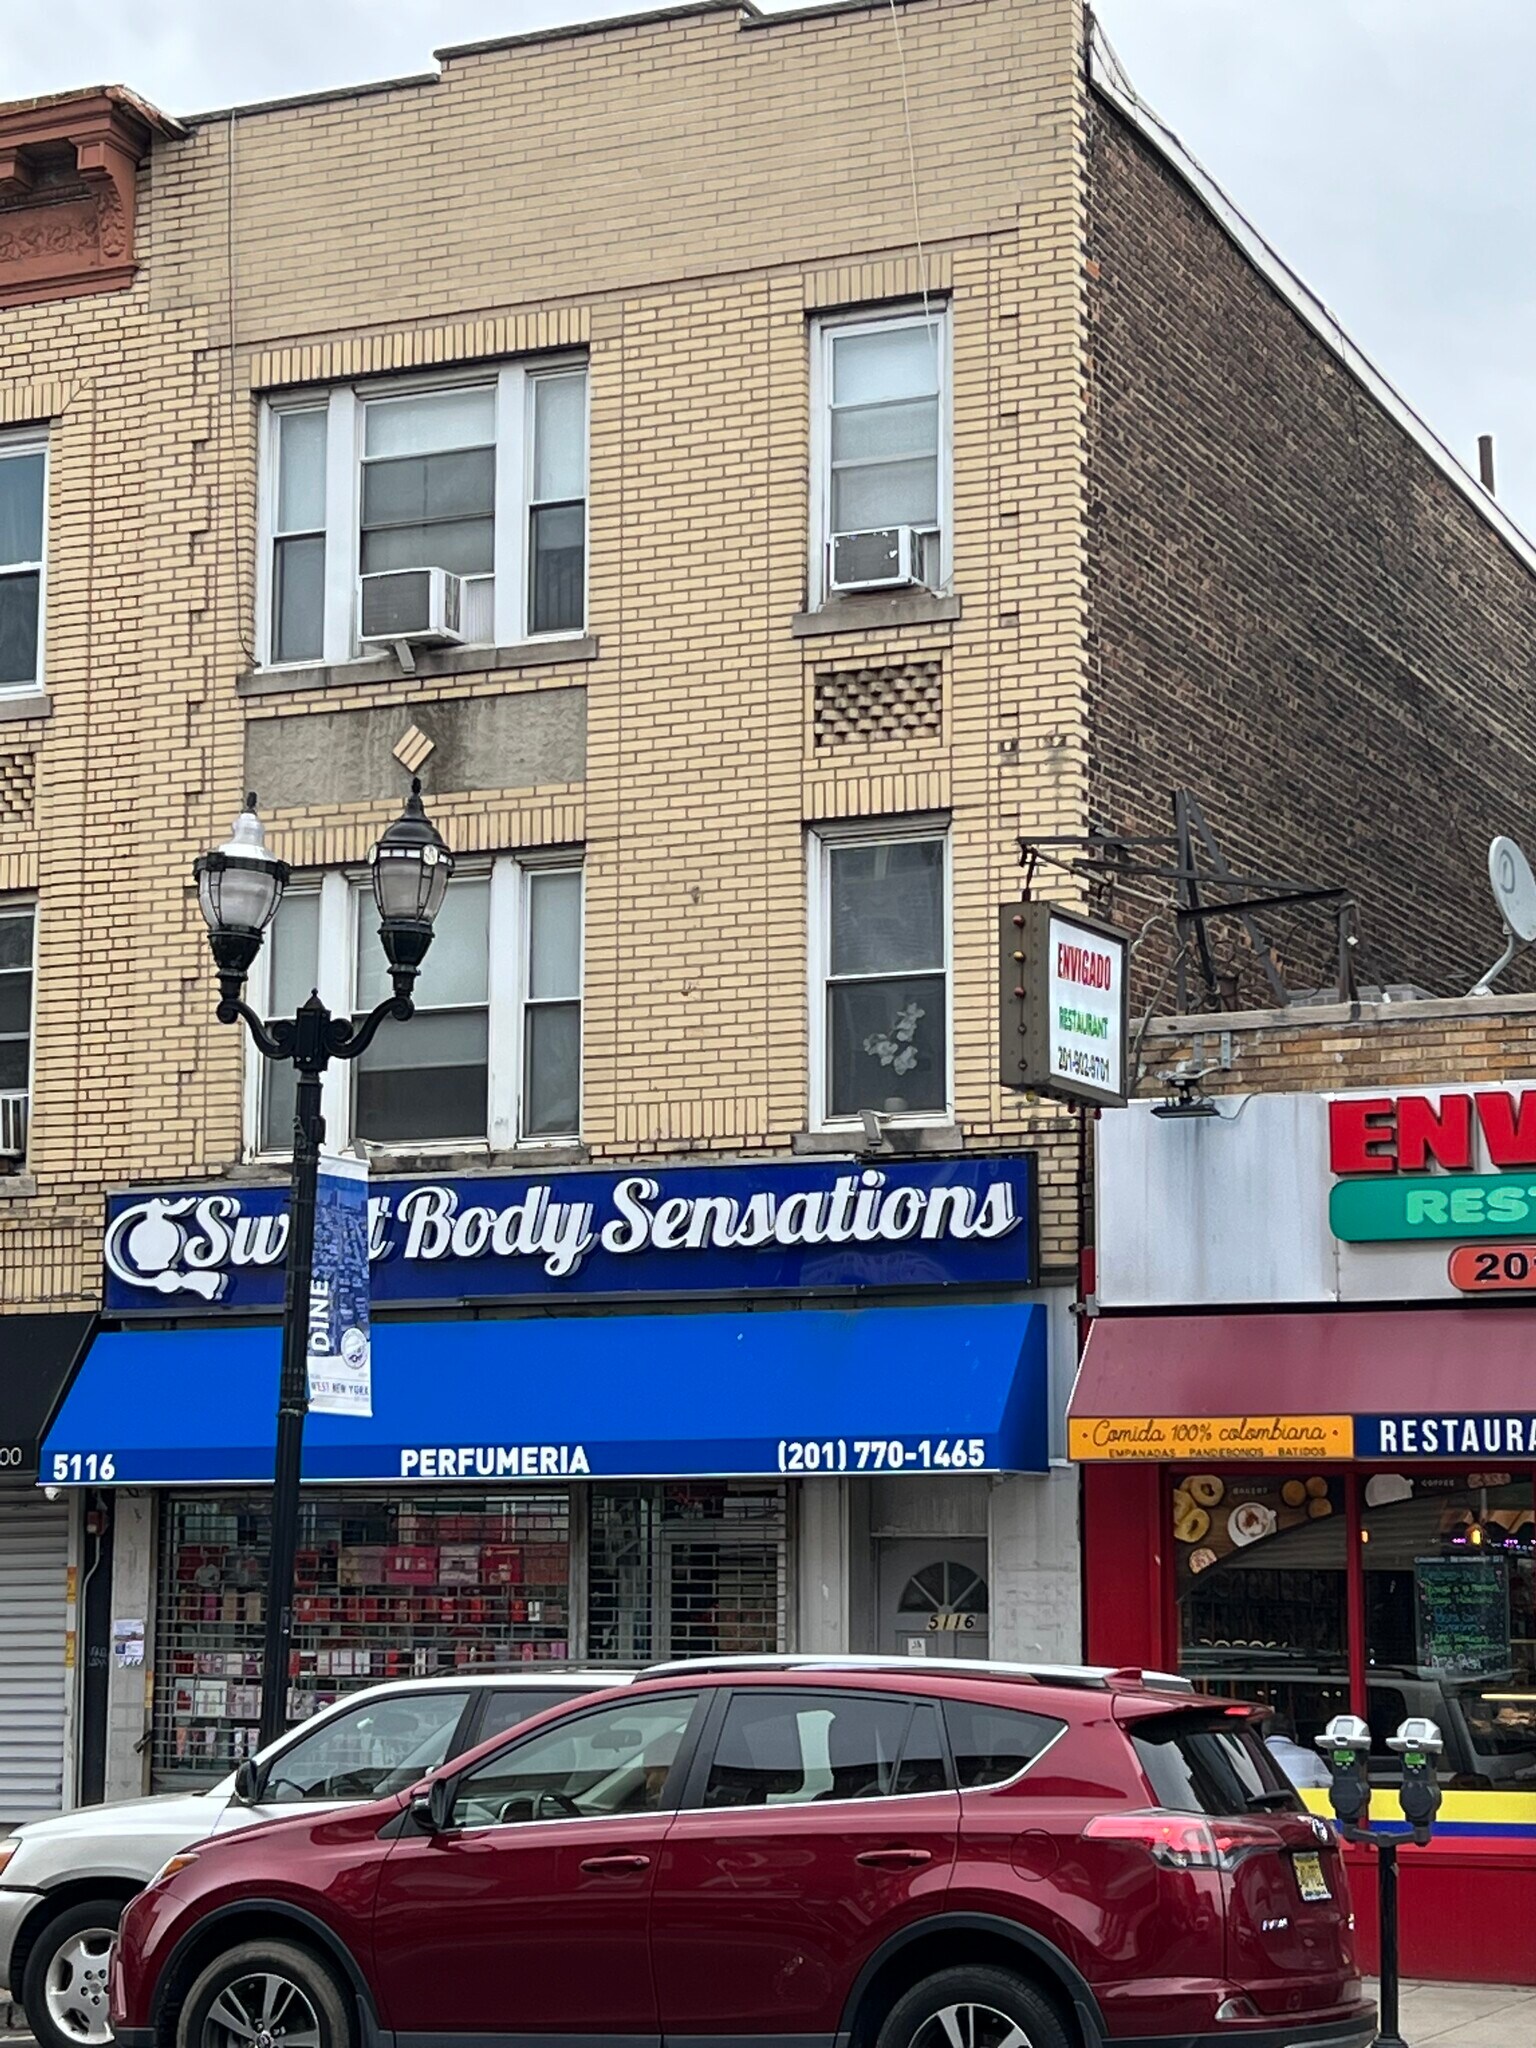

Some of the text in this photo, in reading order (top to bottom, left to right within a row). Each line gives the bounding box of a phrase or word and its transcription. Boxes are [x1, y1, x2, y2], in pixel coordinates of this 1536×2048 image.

[1058, 942, 1111, 991] ENVIGADO
[1059, 1006, 1108, 1040] RESTAURANT
[1406, 1187, 1536, 1225] RES
[184, 1169, 1022, 1277] Swt Body Sensations
[1474, 1253, 1536, 1281] 20
[309, 1280, 330, 1352] DINE
[311, 1381, 369, 1396] WEST NEW YORK
[1093, 1417, 1327, 1446] Comida 100% colombiana
[53, 1453, 115, 1480] 5116
[400, 1446, 590, 1476] PERFUMERIA
[778, 1439, 985, 1472] (201) 770-1465
[1109, 1448, 1176, 1458] EMPANADAS
[1278, 1446, 1326, 1457] BATIDOS
[929, 1614, 976, 1630] 5116
